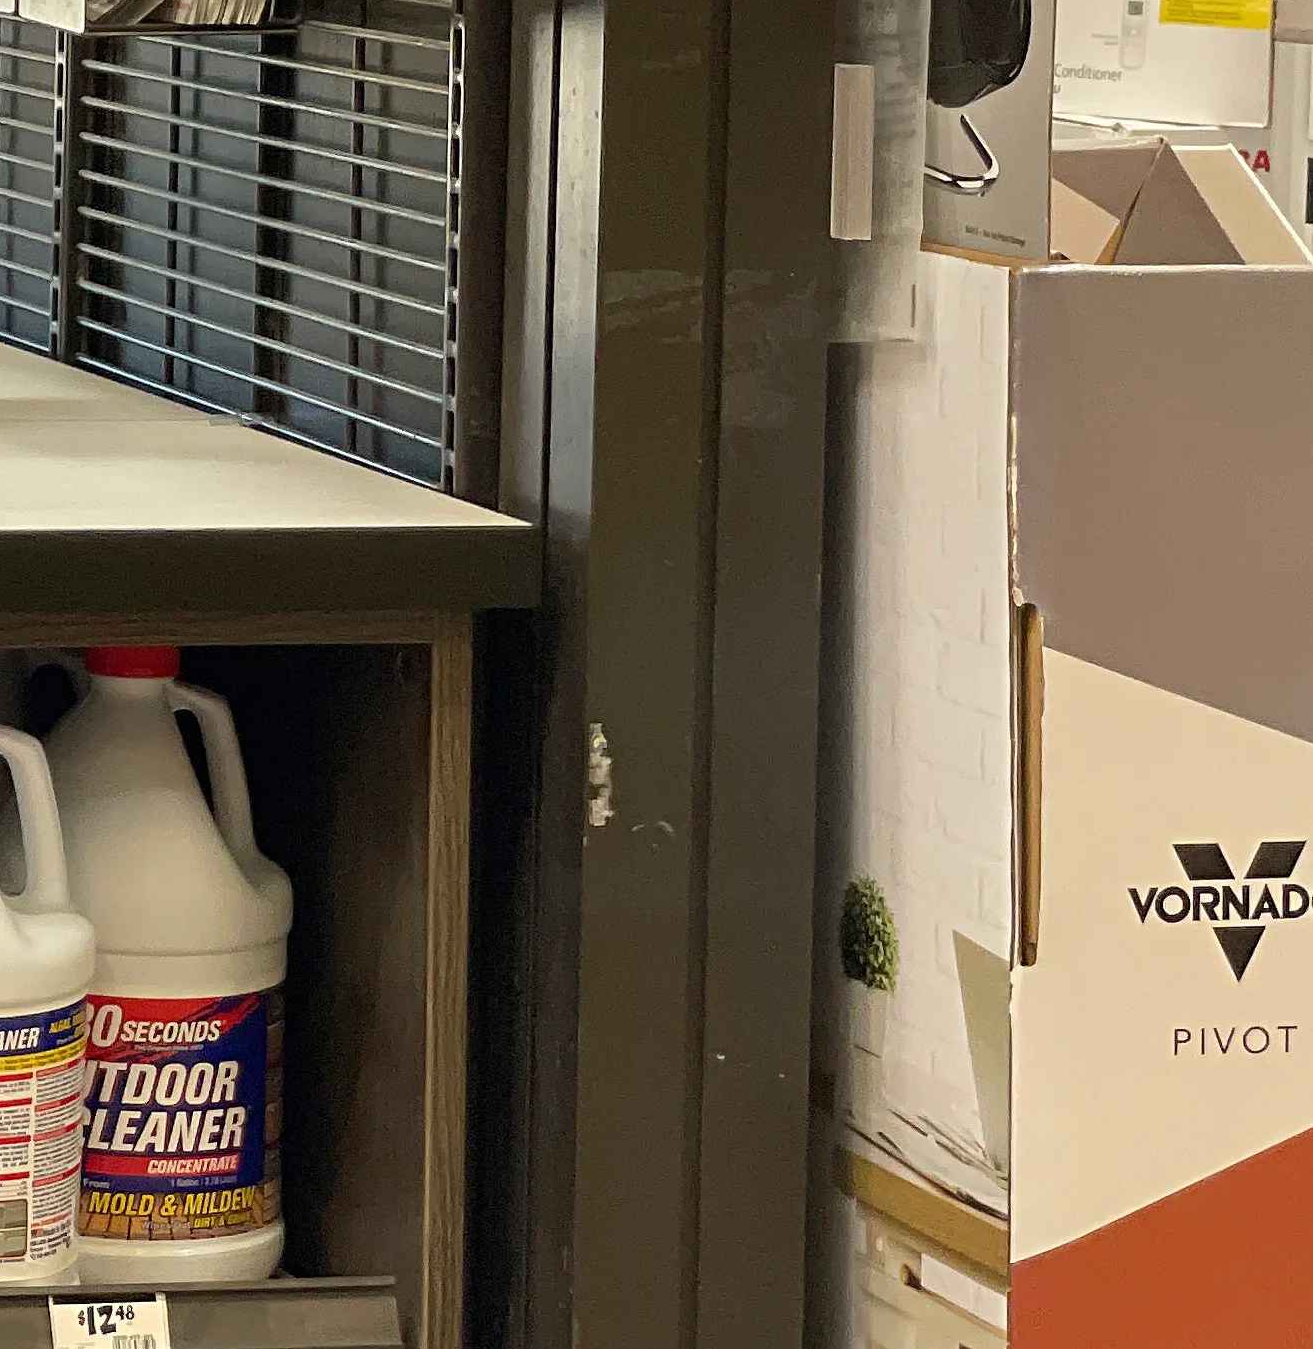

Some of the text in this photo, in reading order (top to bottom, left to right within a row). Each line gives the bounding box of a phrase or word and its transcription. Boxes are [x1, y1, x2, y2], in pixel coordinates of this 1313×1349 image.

[1128, 884, 1313, 924] VORNAD
[120, 1020, 222, 1044] SECONDS
[1173, 1025, 1298, 1056] PIVOT
